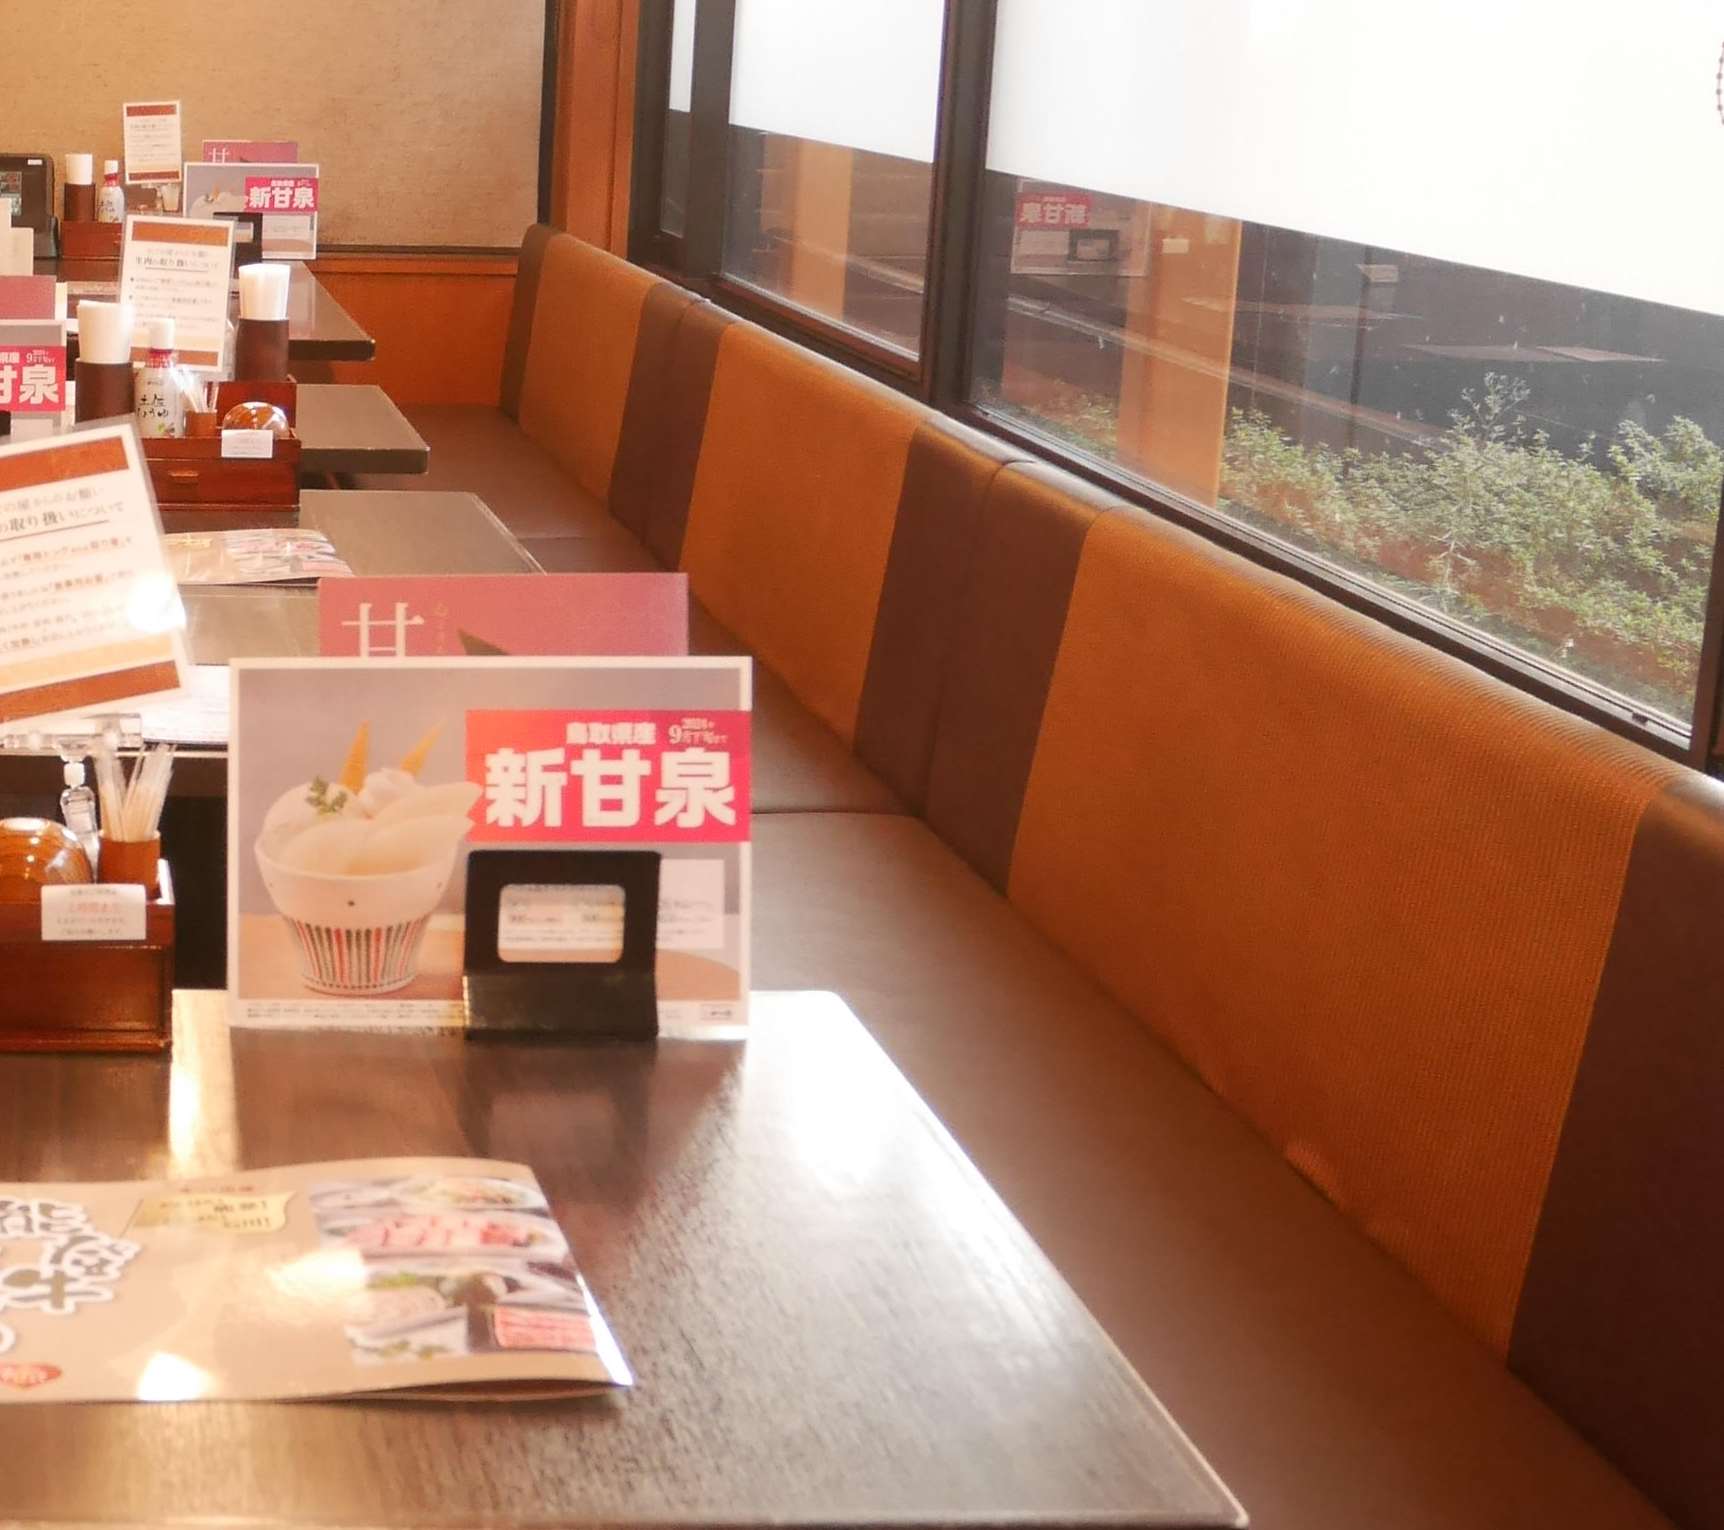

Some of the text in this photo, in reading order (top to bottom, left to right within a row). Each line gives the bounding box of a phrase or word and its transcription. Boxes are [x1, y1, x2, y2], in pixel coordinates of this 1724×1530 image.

[249, 186, 314, 209] 新甘泉
[340, 601, 426, 657] 甘
[566, 722, 657, 745] 鳥取県産
[485, 747, 737, 829] 新甘泉
